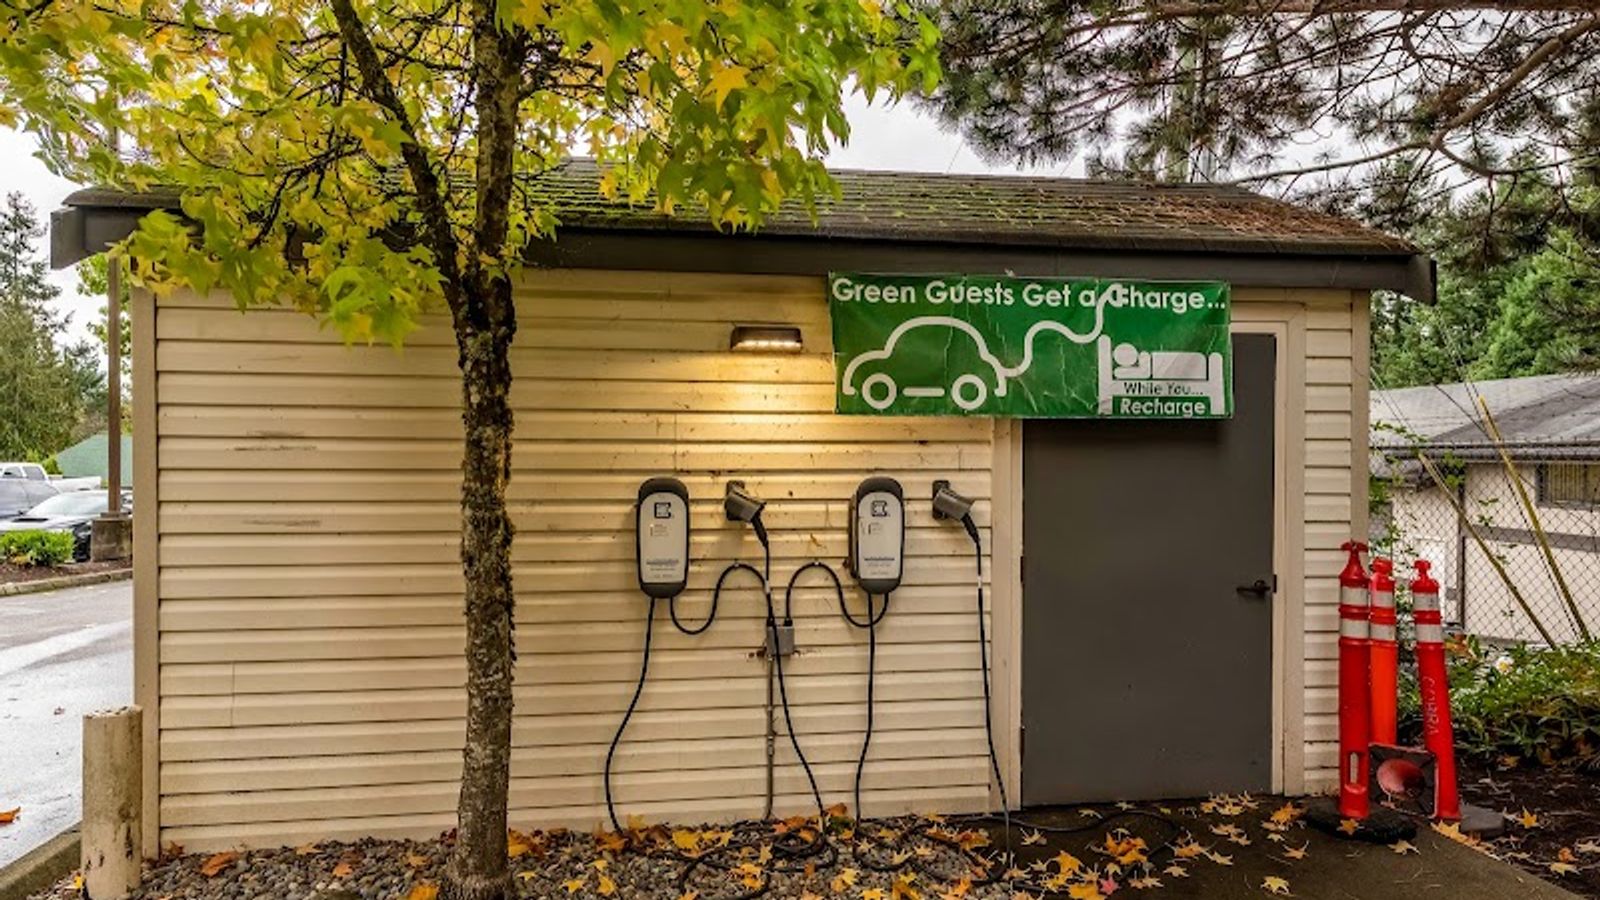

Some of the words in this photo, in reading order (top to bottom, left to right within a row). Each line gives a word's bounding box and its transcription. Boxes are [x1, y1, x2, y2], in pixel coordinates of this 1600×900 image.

[832, 278, 916, 303] Green
[925, 280, 1015, 306] Guests
[1022, 283, 1071, 308] Get
[1079, 289, 1096, 307] a
[1124, 382, 1162, 395] While
[1166, 382, 1204, 395] You...
[1120, 398, 1206, 418] Recharge
